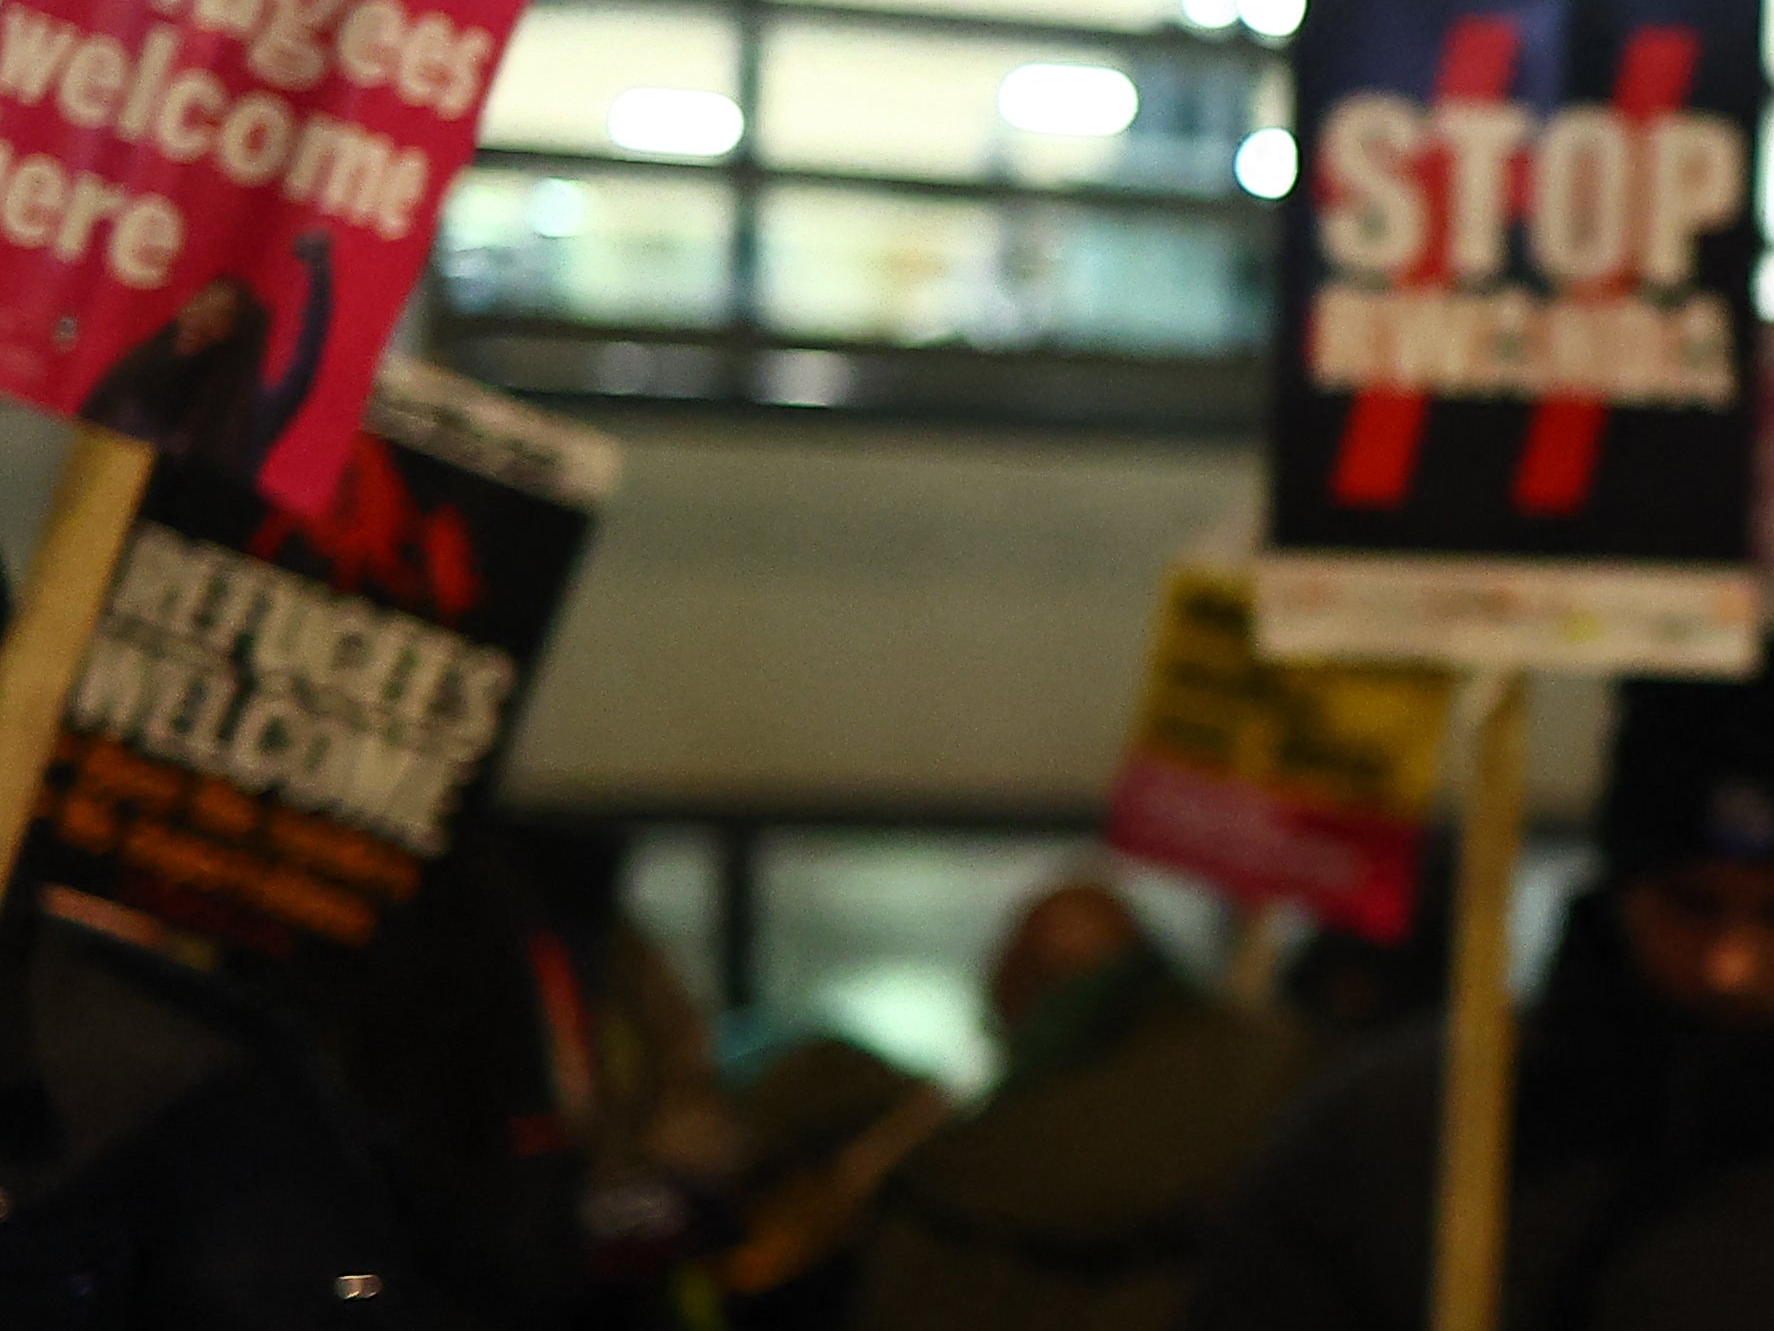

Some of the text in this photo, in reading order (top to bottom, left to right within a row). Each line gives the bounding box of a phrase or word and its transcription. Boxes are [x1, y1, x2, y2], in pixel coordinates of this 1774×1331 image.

[0, 3, 431, 245] welcome
[0, 135, 187, 290] ere
[1315, 92, 1750, 290] STOP
